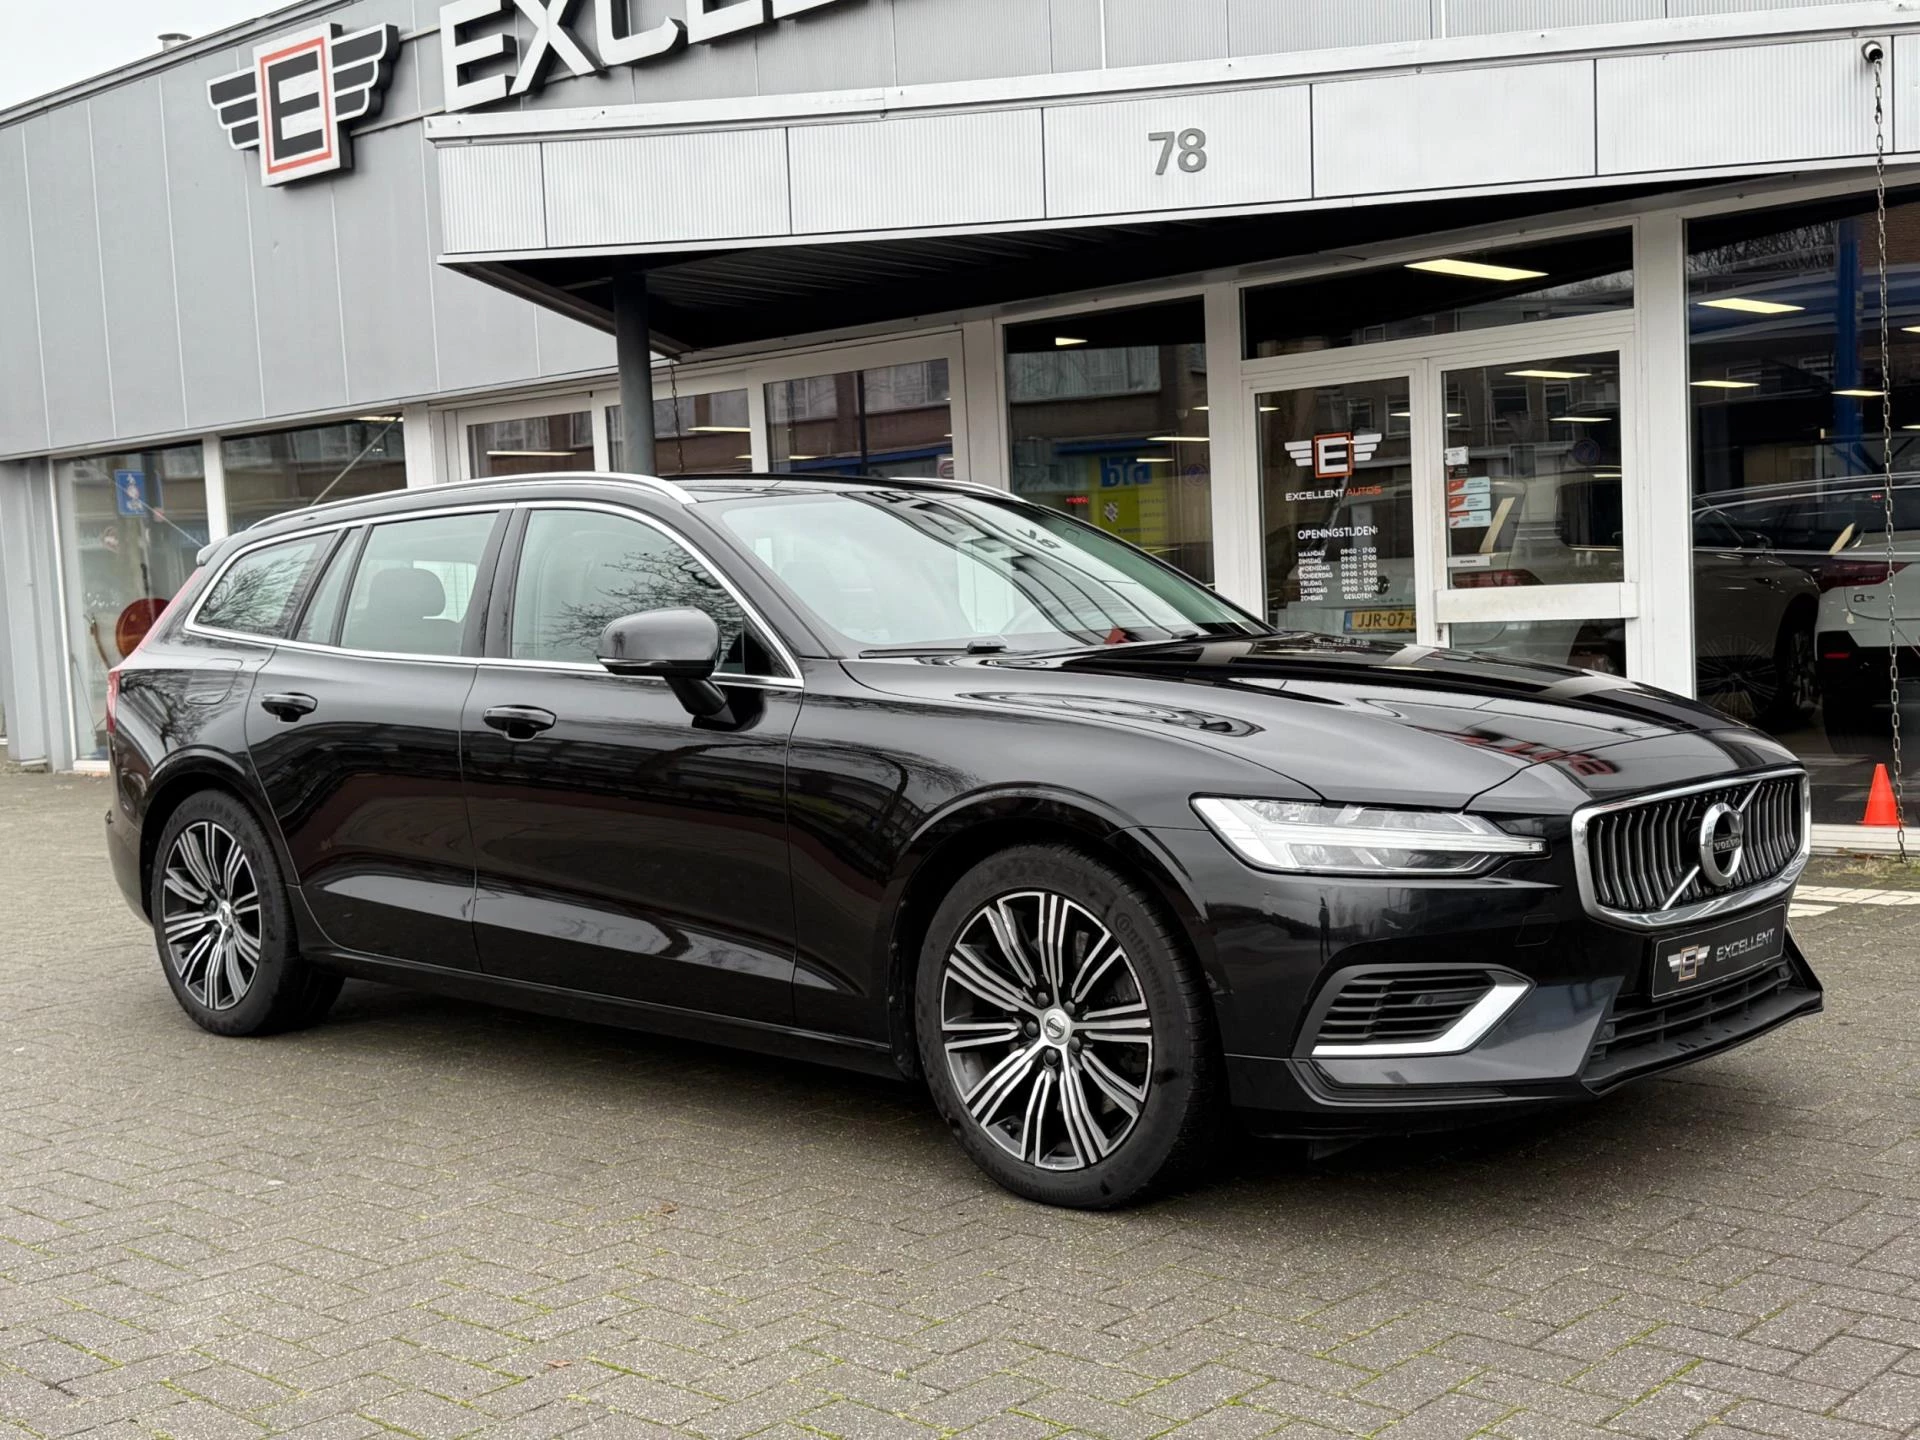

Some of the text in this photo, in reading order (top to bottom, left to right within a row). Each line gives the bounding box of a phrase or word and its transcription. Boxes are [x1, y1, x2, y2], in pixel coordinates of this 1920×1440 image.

[440, 0, 836, 113] EXC
[1148, 127, 1208, 176] 78
[1285, 485, 1383, 501] EXCELLENT AUTOS
[1297, 525, 1378, 540] OPENINGSTIJDEN:
[1714, 837, 1741, 851] VOLVO
[1716, 928, 1775, 962] EXCELLENT
